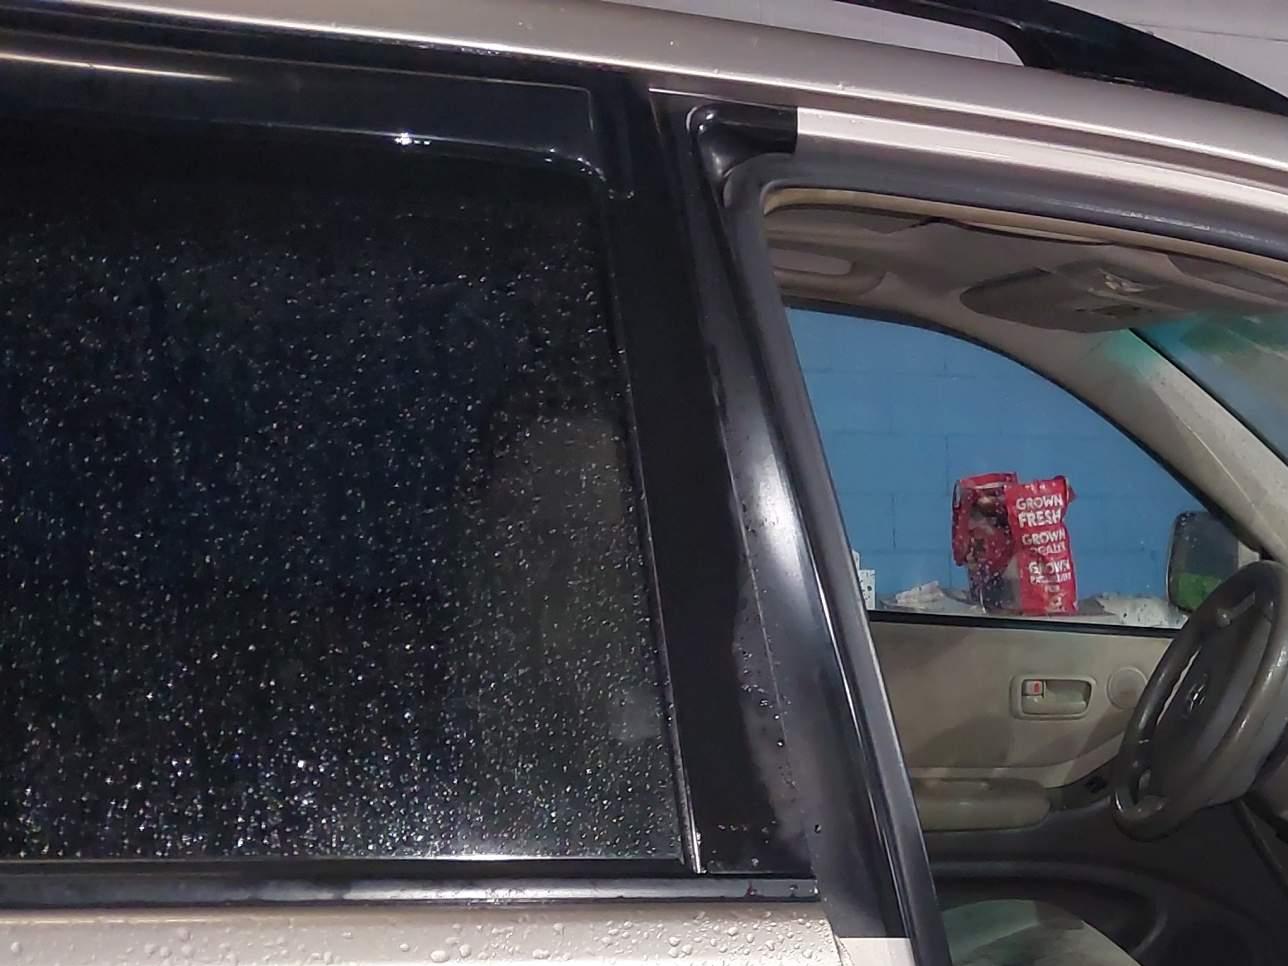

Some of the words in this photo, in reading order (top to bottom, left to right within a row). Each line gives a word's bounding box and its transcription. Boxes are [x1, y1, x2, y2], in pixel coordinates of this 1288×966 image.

[1016, 494, 1064, 510] GROWN
[1018, 509, 1062, 528] FRESH
[1022, 528, 1066, 545] GROWN
